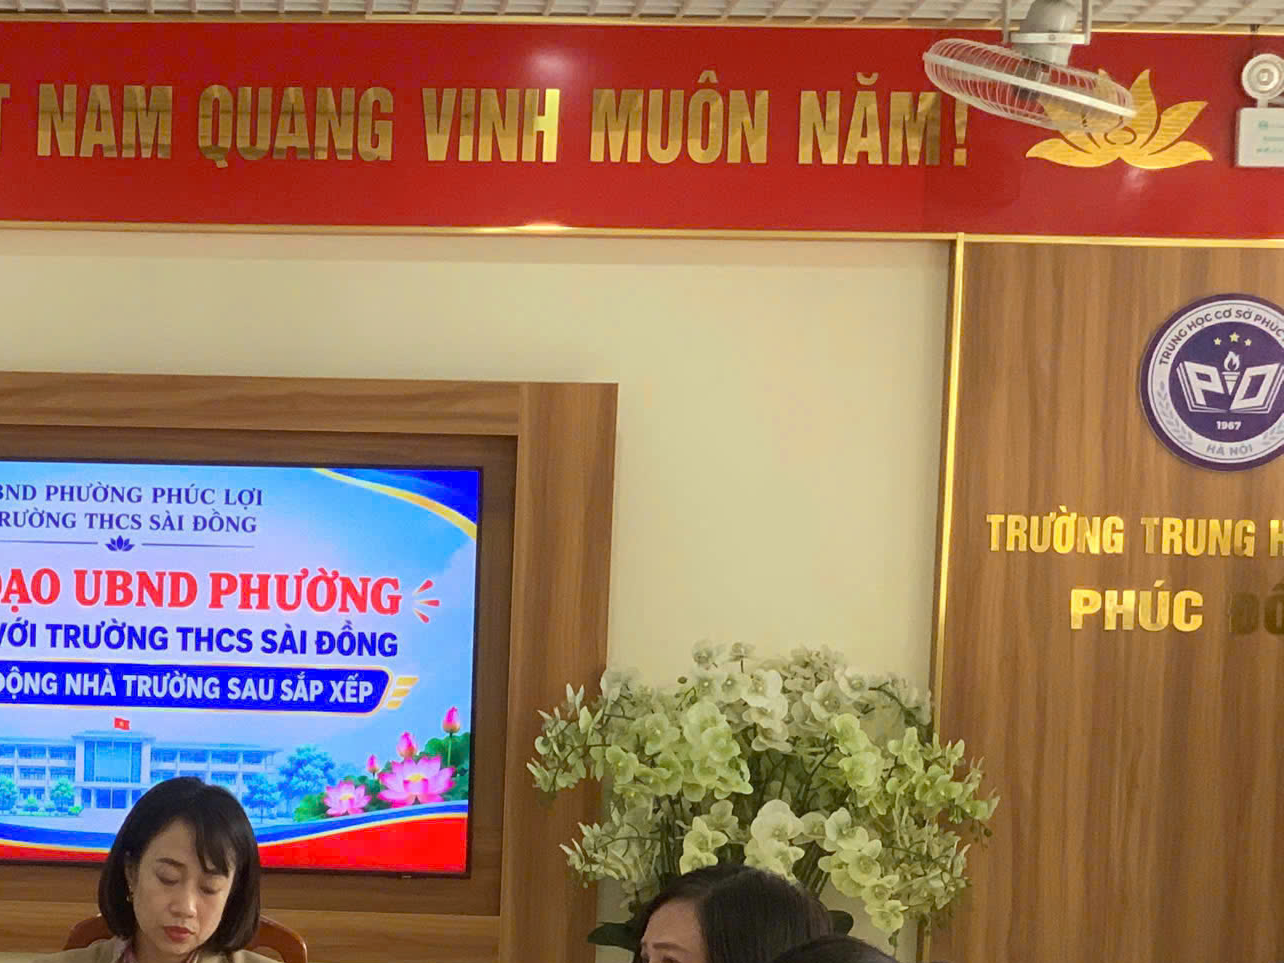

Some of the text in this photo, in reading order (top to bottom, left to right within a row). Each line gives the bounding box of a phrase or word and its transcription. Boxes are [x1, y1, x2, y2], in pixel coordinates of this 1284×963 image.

[37, 83, 173, 160] NAM
[197, 83, 394, 168] QUANG
[422, 86, 561, 165] VINH
[589, 70, 769, 166] MUÔN
[1159, 328, 1188, 366] TRUNG
[1187, 313, 1212, 331] HỌC
[1214, 308, 1232, 319] CƠ
[1216, 420, 1242, 431] 1967
[45, 481, 143, 503] PHƯỜNG
[151, 483, 215, 505] PHÚC
[224, 487, 263, 510] LỢI
[84, 512, 142, 531] THCS
[149, 510, 184, 532] SÀI
[192, 508, 257, 533] ĐỒNG
[986, 505, 1124, 555] TRƯỜNG
[1141, 516, 1256, 558] TRUNG
[73, 569, 198, 608] UBND
[208, 567, 402, 616] PHƯỜNG
[1070, 579, 1204, 632] PHÚC
[45, 618, 168, 651] TRƯỜNG
[175, 626, 253, 653] THCS
[260, 623, 307, 655] SÀI
[315, 619, 398, 657] ĐỒNG
[64, 668, 116, 697] NHÀ
[123, 671, 220, 699] TRƯỜNG
[227, 677, 274, 701] SAU
[280, 672, 324, 702] SẮP
[328, 672, 374, 703] XẾP
